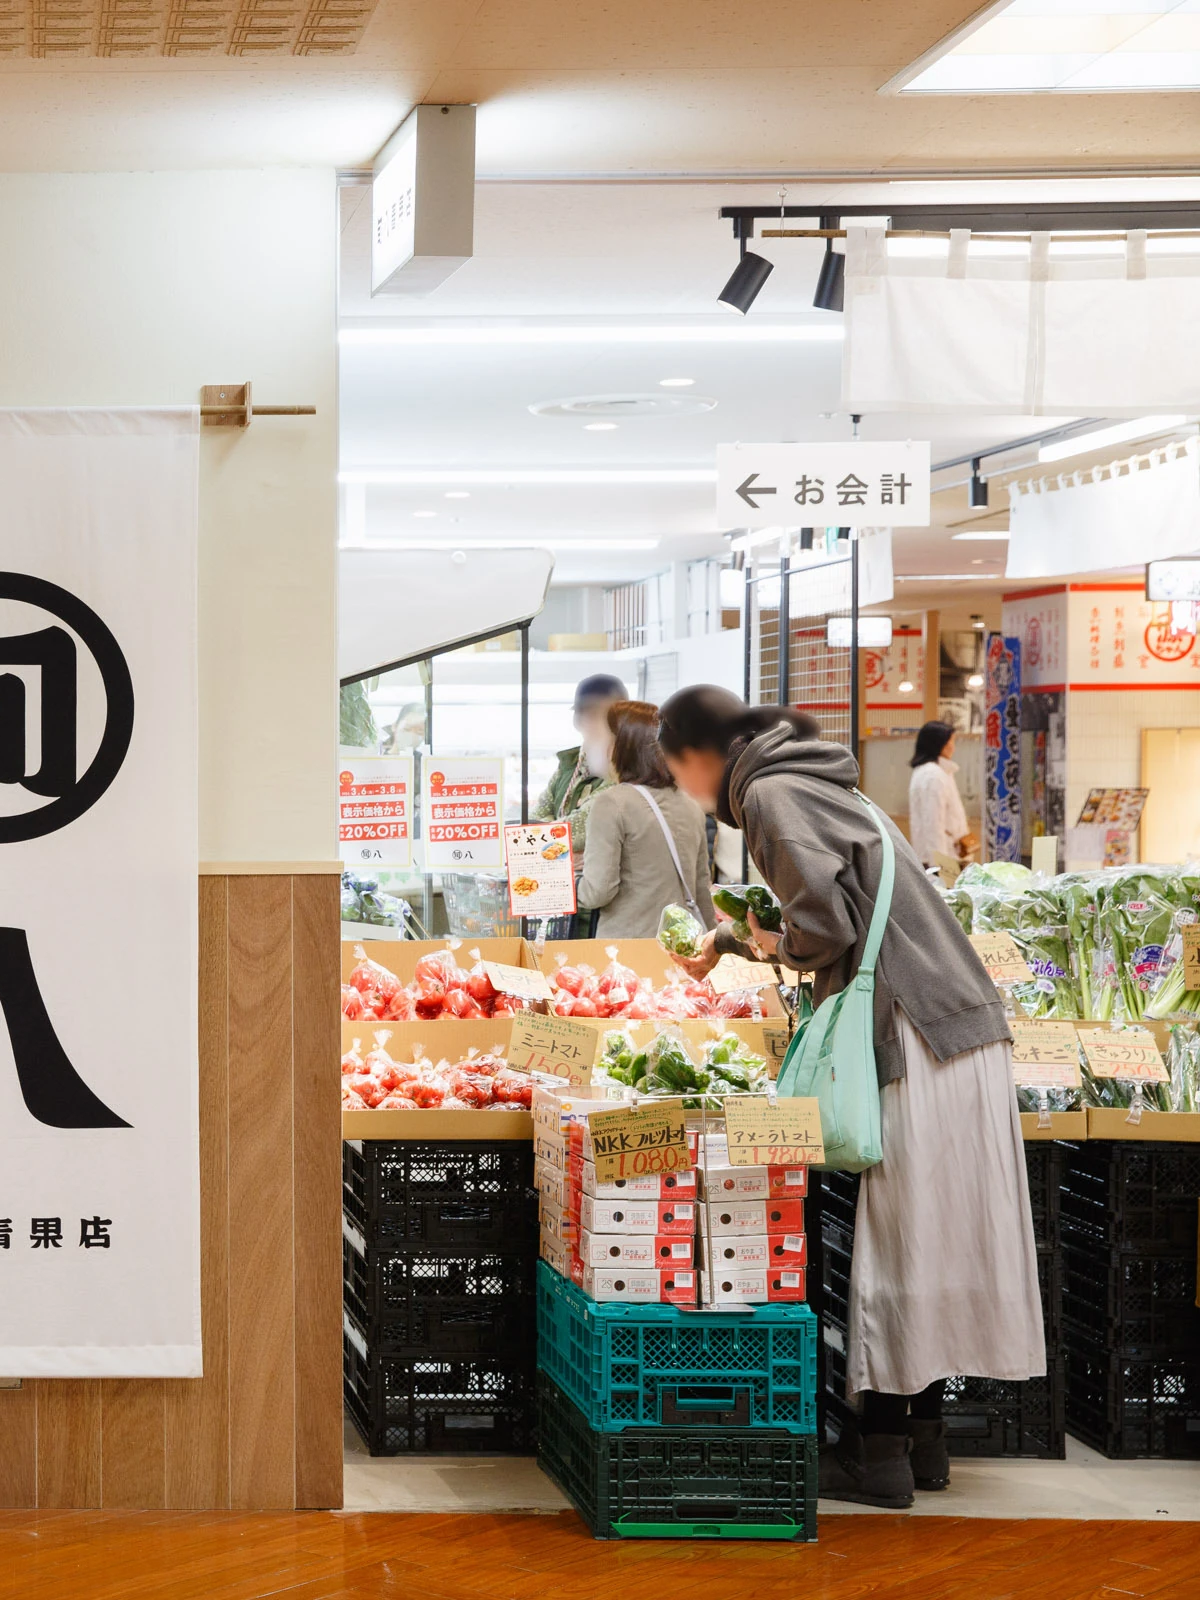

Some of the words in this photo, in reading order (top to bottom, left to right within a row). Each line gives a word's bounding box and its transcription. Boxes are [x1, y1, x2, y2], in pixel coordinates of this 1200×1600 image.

[794, 473, 912, 505] お会計
[343, 804, 403, 818] 表示価格から
[434, 804, 495, 819] 表示価格から
[345, 824, 405, 839] 20%OFF
[436, 825, 496, 839] 20%OFF
[361, 849, 382, 859] 旬八
[452, 850, 473, 860] 旬八
[521, 1033, 582, 1058] ミニトマト
[1095, 1045, 1146, 1061] きゅうり
[734, 1129, 817, 1143] アメーラトマト
[601, 1279, 612, 1290] 2S
